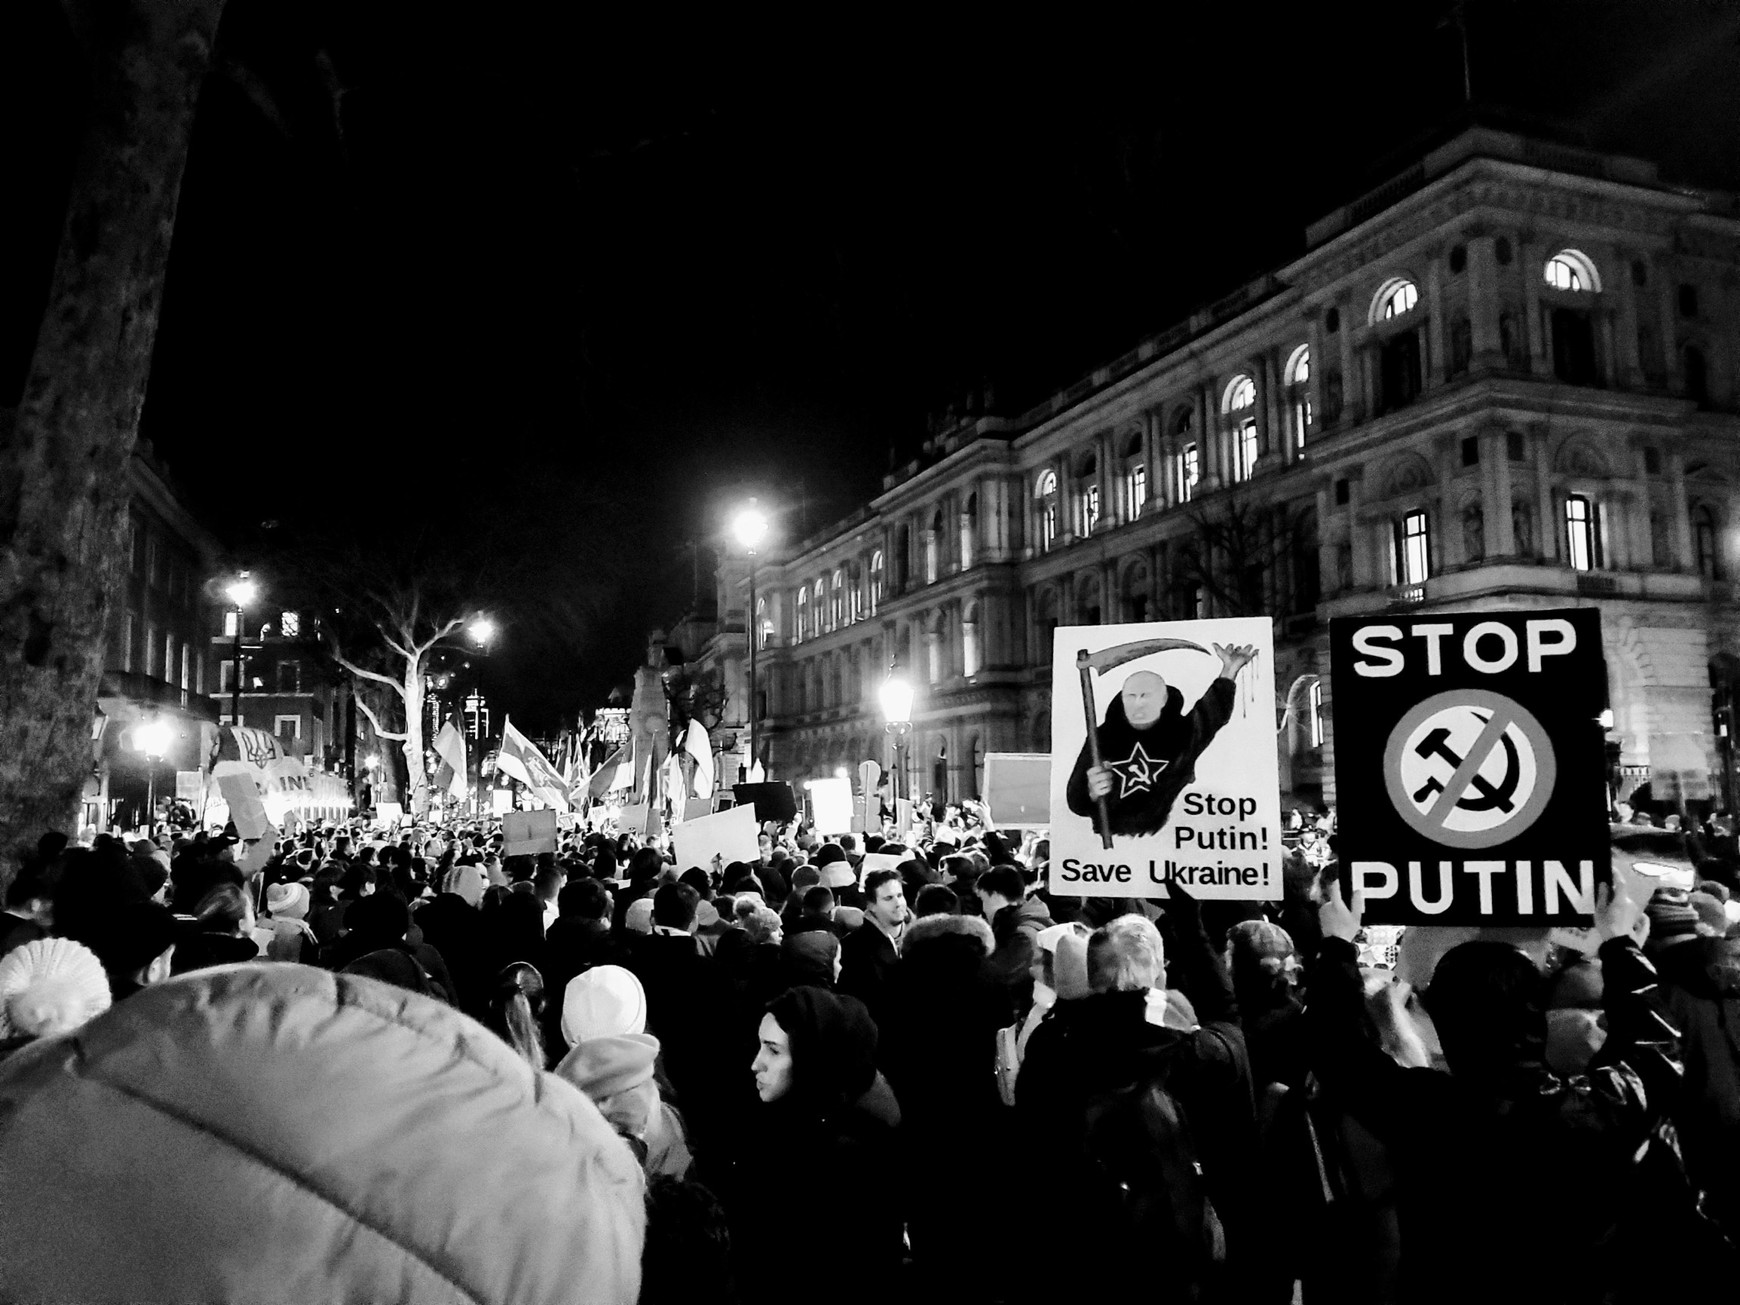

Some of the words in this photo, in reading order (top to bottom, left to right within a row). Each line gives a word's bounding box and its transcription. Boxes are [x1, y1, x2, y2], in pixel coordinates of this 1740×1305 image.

[1352, 618, 1577, 678] STOP
[1183, 792, 1257, 822] Stop
[1174, 825, 1268, 851] Putin!
[1061, 858, 1132, 883] Save
[1149, 859, 1270, 886] Ukraine!
[1351, 859, 1596, 915] PUTIN
